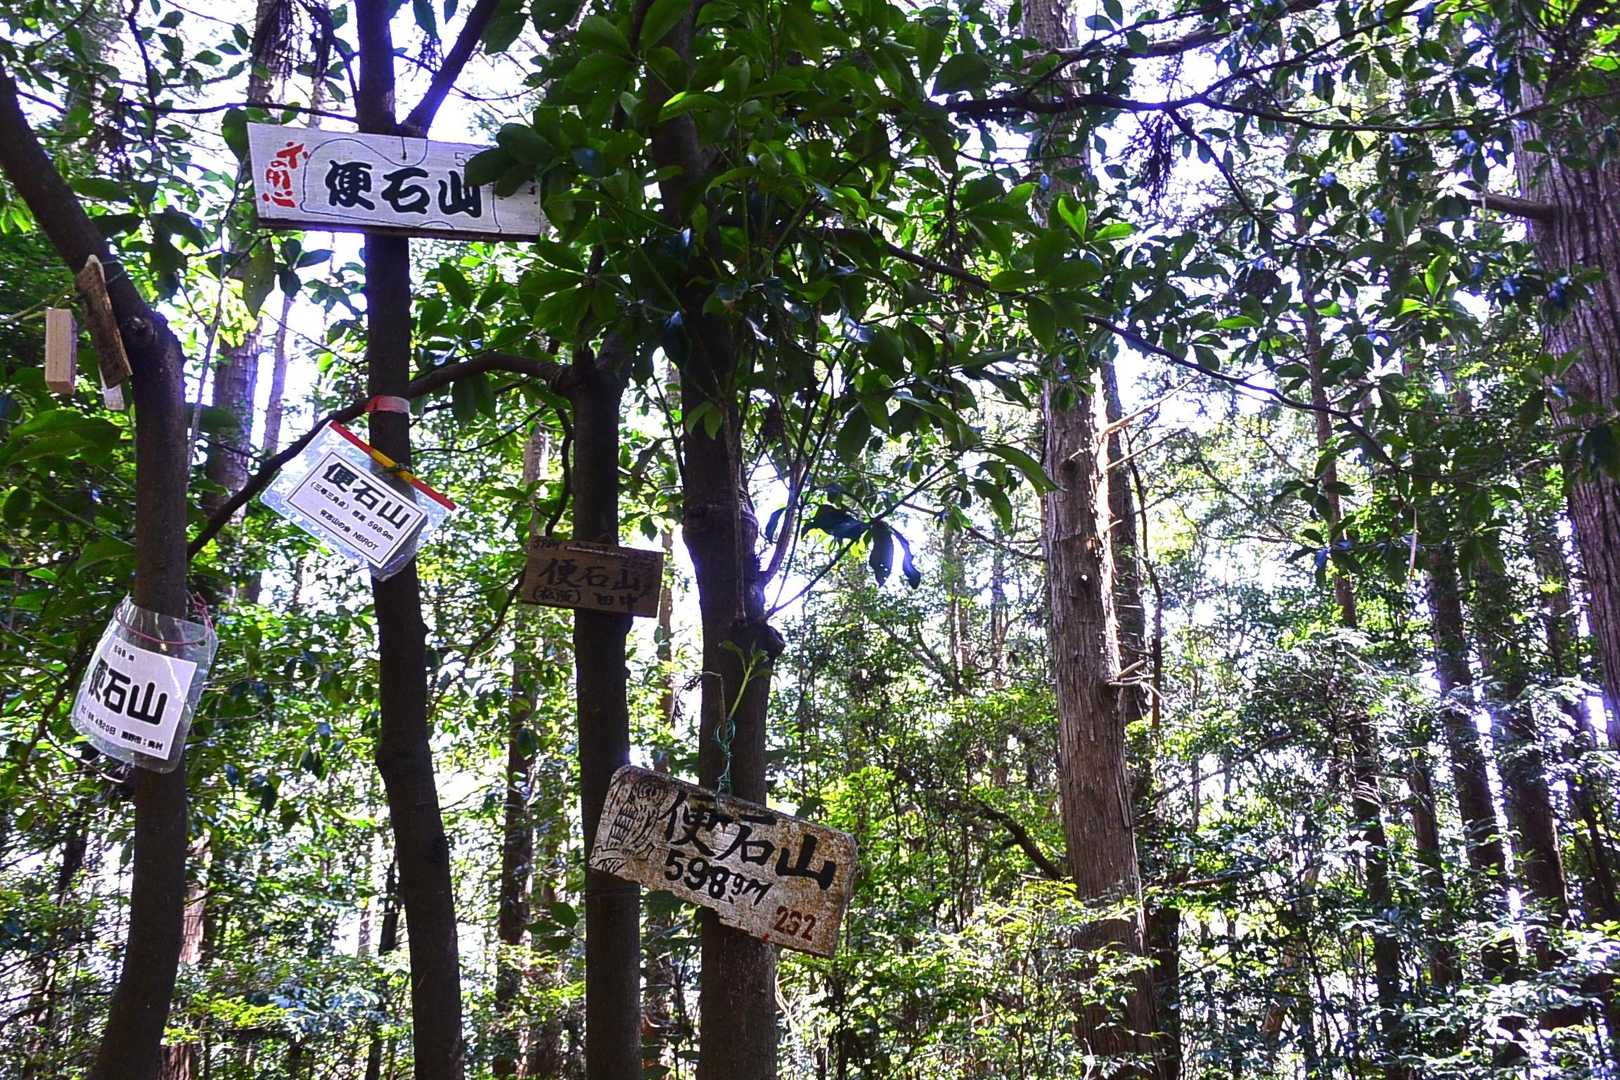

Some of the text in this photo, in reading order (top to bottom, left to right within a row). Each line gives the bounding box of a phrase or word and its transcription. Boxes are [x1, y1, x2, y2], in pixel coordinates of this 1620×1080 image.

[325, 159, 482, 218] 便石山
[322, 461, 411, 530] 便石山
[538, 557, 643, 591] 便石山
[658, 789, 837, 890] 便石山
